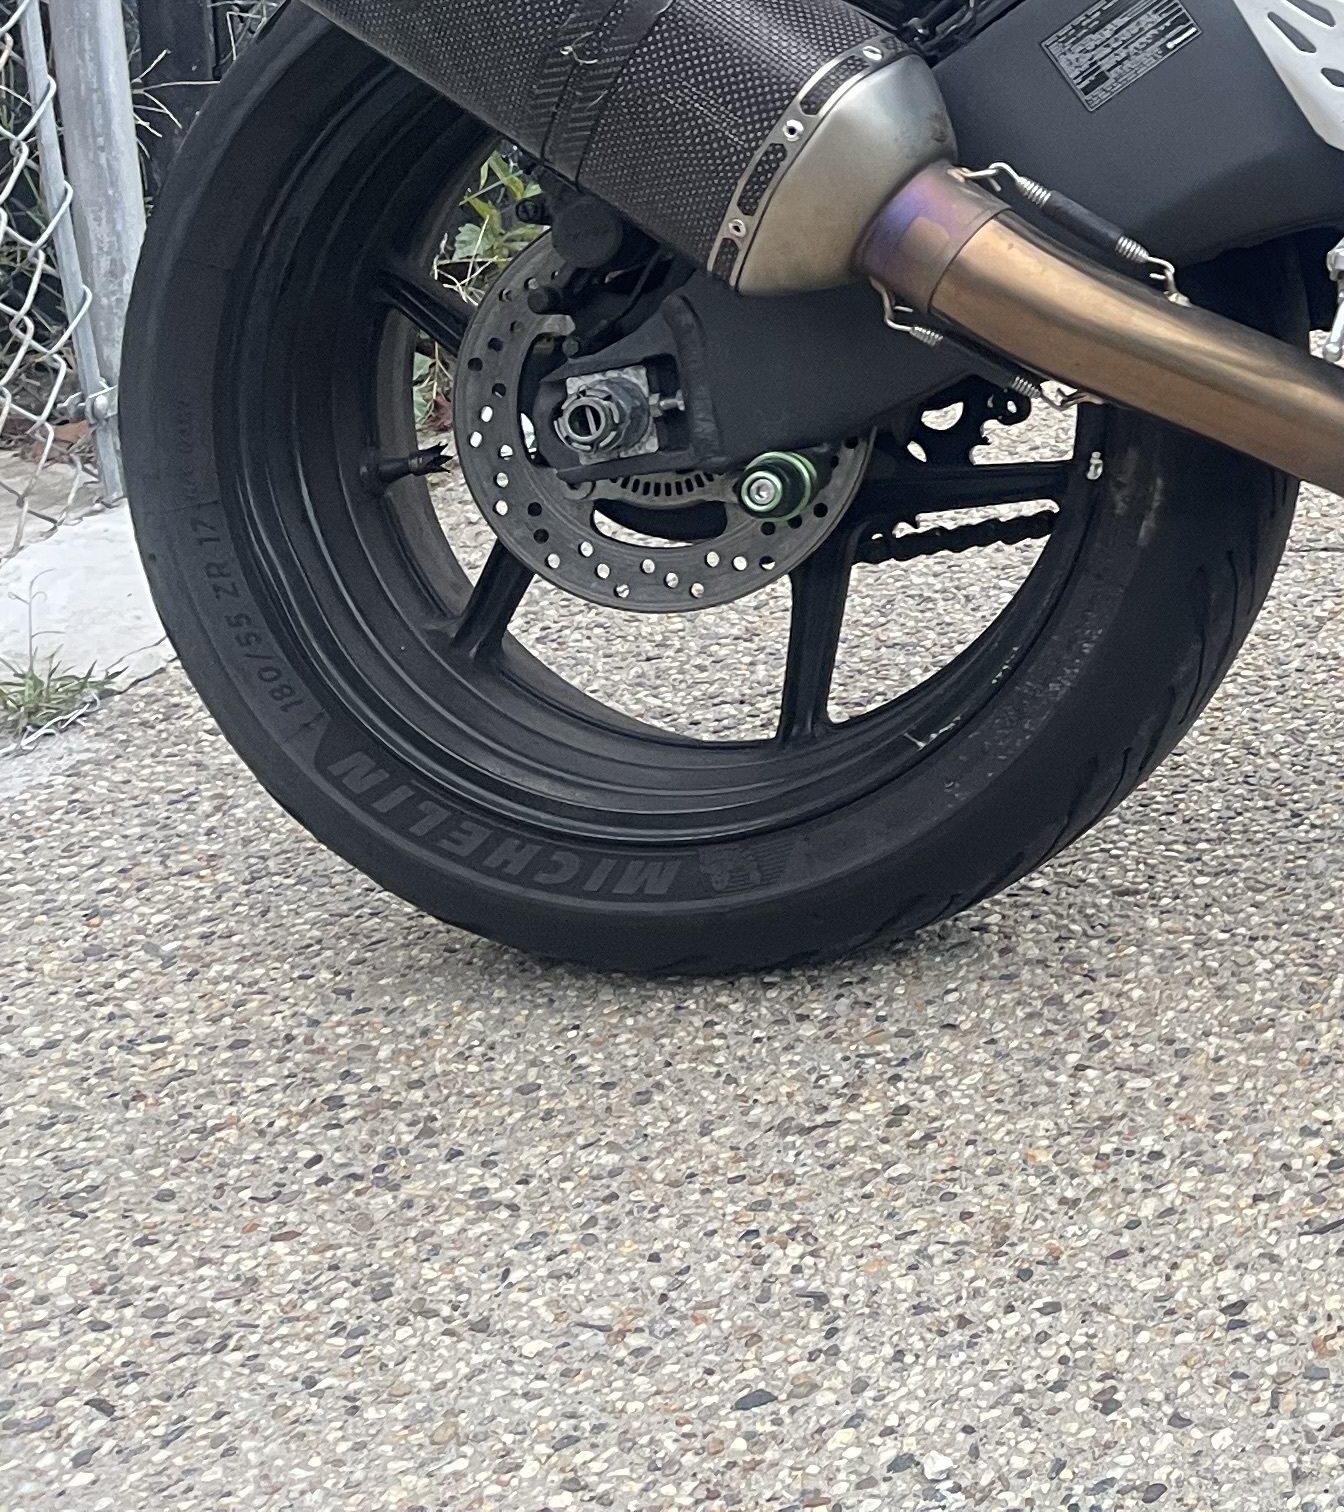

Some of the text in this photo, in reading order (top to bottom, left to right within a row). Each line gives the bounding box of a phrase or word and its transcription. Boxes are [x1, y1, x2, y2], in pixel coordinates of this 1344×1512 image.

[190, 516, 306, 714] 180/55 ZR 17
[326, 750, 682, 895] MICHELIN
